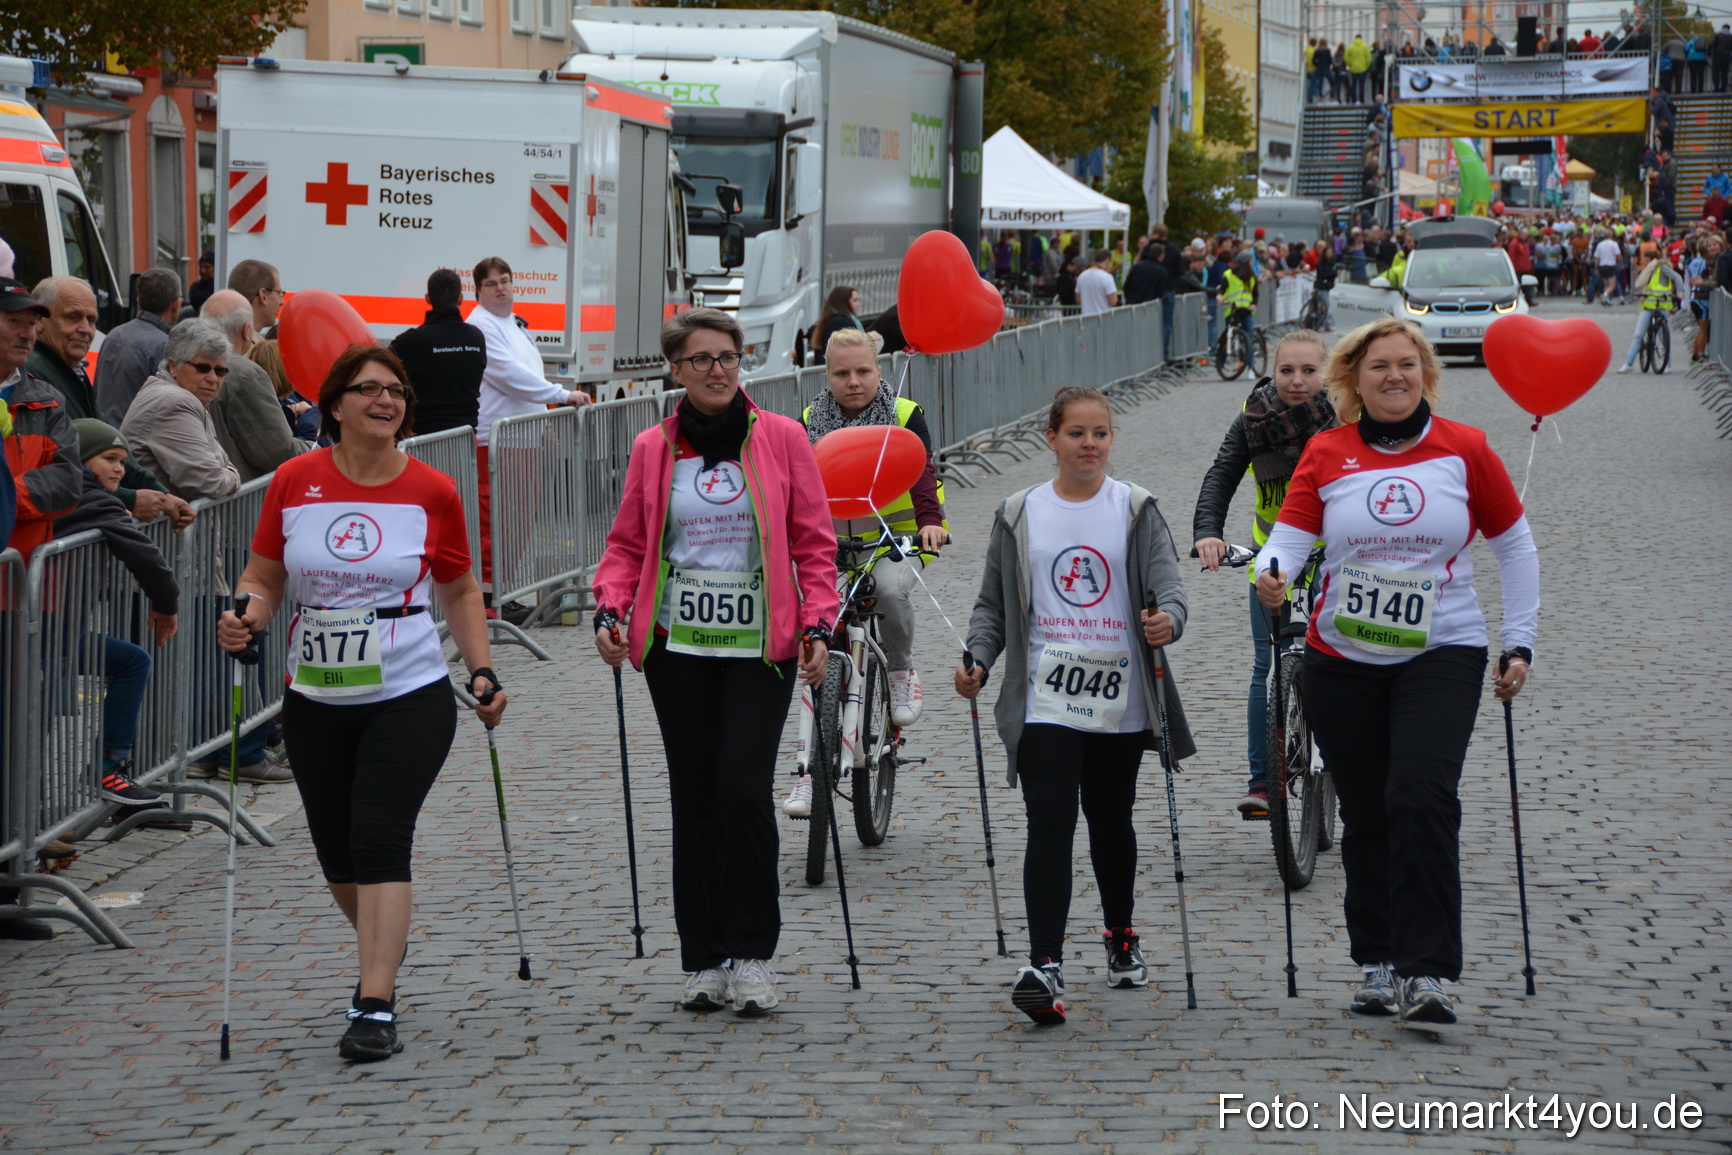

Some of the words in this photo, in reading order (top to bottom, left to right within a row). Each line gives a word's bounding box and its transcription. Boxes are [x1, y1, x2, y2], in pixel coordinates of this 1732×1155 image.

[1474, 108, 1561, 130] START
[523, 147, 562, 159] 44/54/1
[910, 116, 942, 184] BOCK
[380, 164, 495, 185] Bayerisches
[380, 188, 433, 206] Rotes
[379, 212, 433, 230] Kreuz
[989, 207, 1065, 224] Laufsport
[688, 536, 753, 547] Leistungsdiagnostik
[1357, 552, 1428, 564] Leistungsdiagnostik
[675, 577, 701, 587] PARTL
[703, 579, 746, 589] Neumarkt
[1342, 567, 1371, 581] PARTL
[1372, 574, 1418, 589] Neumarkt
[679, 590, 754, 625] 5050
[1346, 582, 1424, 626] 5140
[315, 617, 360, 628] Neumarkt
[1037, 615, 1075, 627] LAUFEN
[1079, 618, 1098, 628] MIT
[692, 630, 737, 645] Carmen
[1096, 633, 1120, 642] Röschl
[1356, 624, 1400, 645] Kerstin
[302, 629, 369, 663] 5177
[1044, 648, 1075, 661] PARTL
[1077, 654, 1117, 667] Neumarkt
[324, 671, 344, 684] Elli
[1045, 663, 1122, 700] 4048
[1066, 703, 1094, 718] Anna
